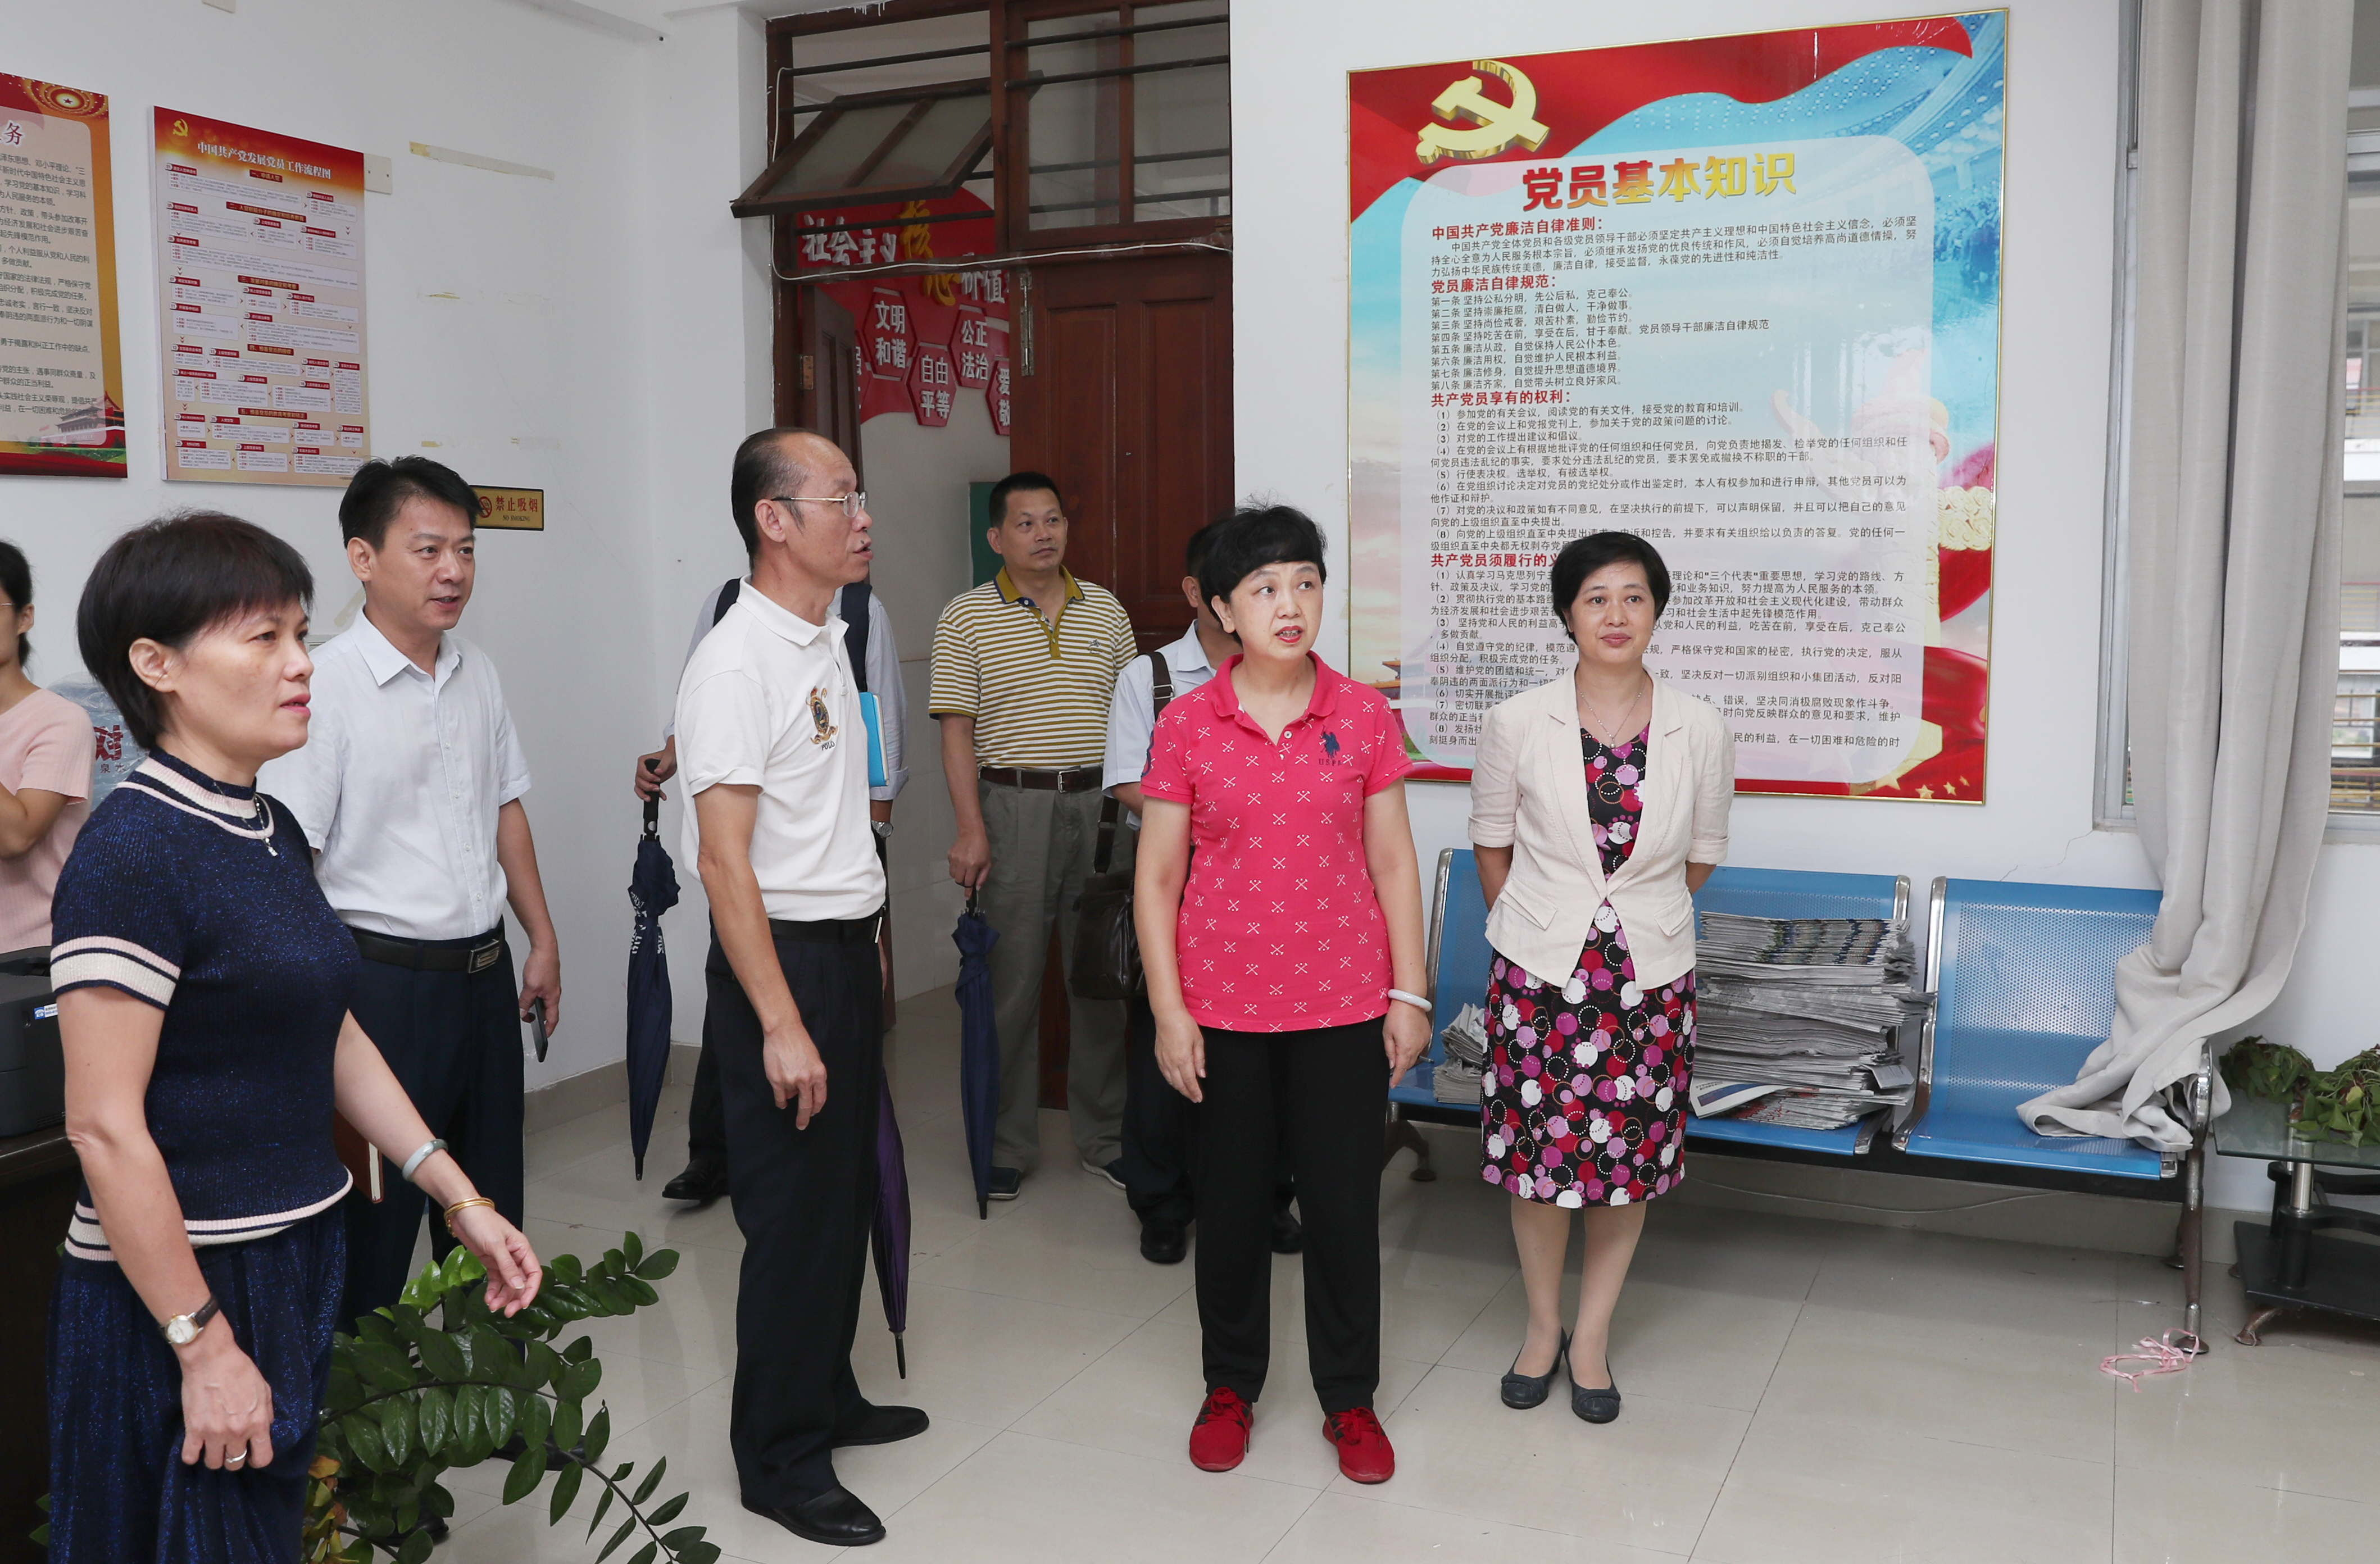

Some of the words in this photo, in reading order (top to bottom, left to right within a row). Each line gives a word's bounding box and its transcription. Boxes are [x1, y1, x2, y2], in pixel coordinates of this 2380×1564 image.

[197, 142, 331, 179] 中国共产党发展党员工作流程图
[1522, 152, 1797, 212] 党员基本知识
[1432, 216, 1603, 240] 中国共产党廉洁自律准则：
[960, 270, 1009, 304] 价值
[1431, 275, 1557, 294] 党员廉洁自律规范：
[1431, 295, 1460, 307] 第一条
[875, 301, 906, 334] 文明
[1431, 308, 1460, 319] 第二条
[961, 320, 988, 348] 公正
[1431, 320, 1460, 331] 第三条
[1431, 333, 1460, 343] 第四条
[875, 337, 906, 369] 和谐
[1431, 344, 1460, 355] 第五条
[921, 354, 948, 385] 自由
[961, 351, 988, 380] 法治
[1431, 357, 1460, 367] 第六条
[0, 365, 96, 380] 党的主张，遇事同群众商量，及
[1431, 369, 1460, 380] 第七条
[1431, 380, 1460, 391] 第八条
[920, 390, 950, 419] 平等
[1431, 389, 1571, 407] 共产党员享有的权利：
[496, 495, 538, 512] 禁止吸烟
[1661, 608, 1822, 619] 习和社会生活中起先锋模范作用。
[821, 740, 835, 751] POLO
